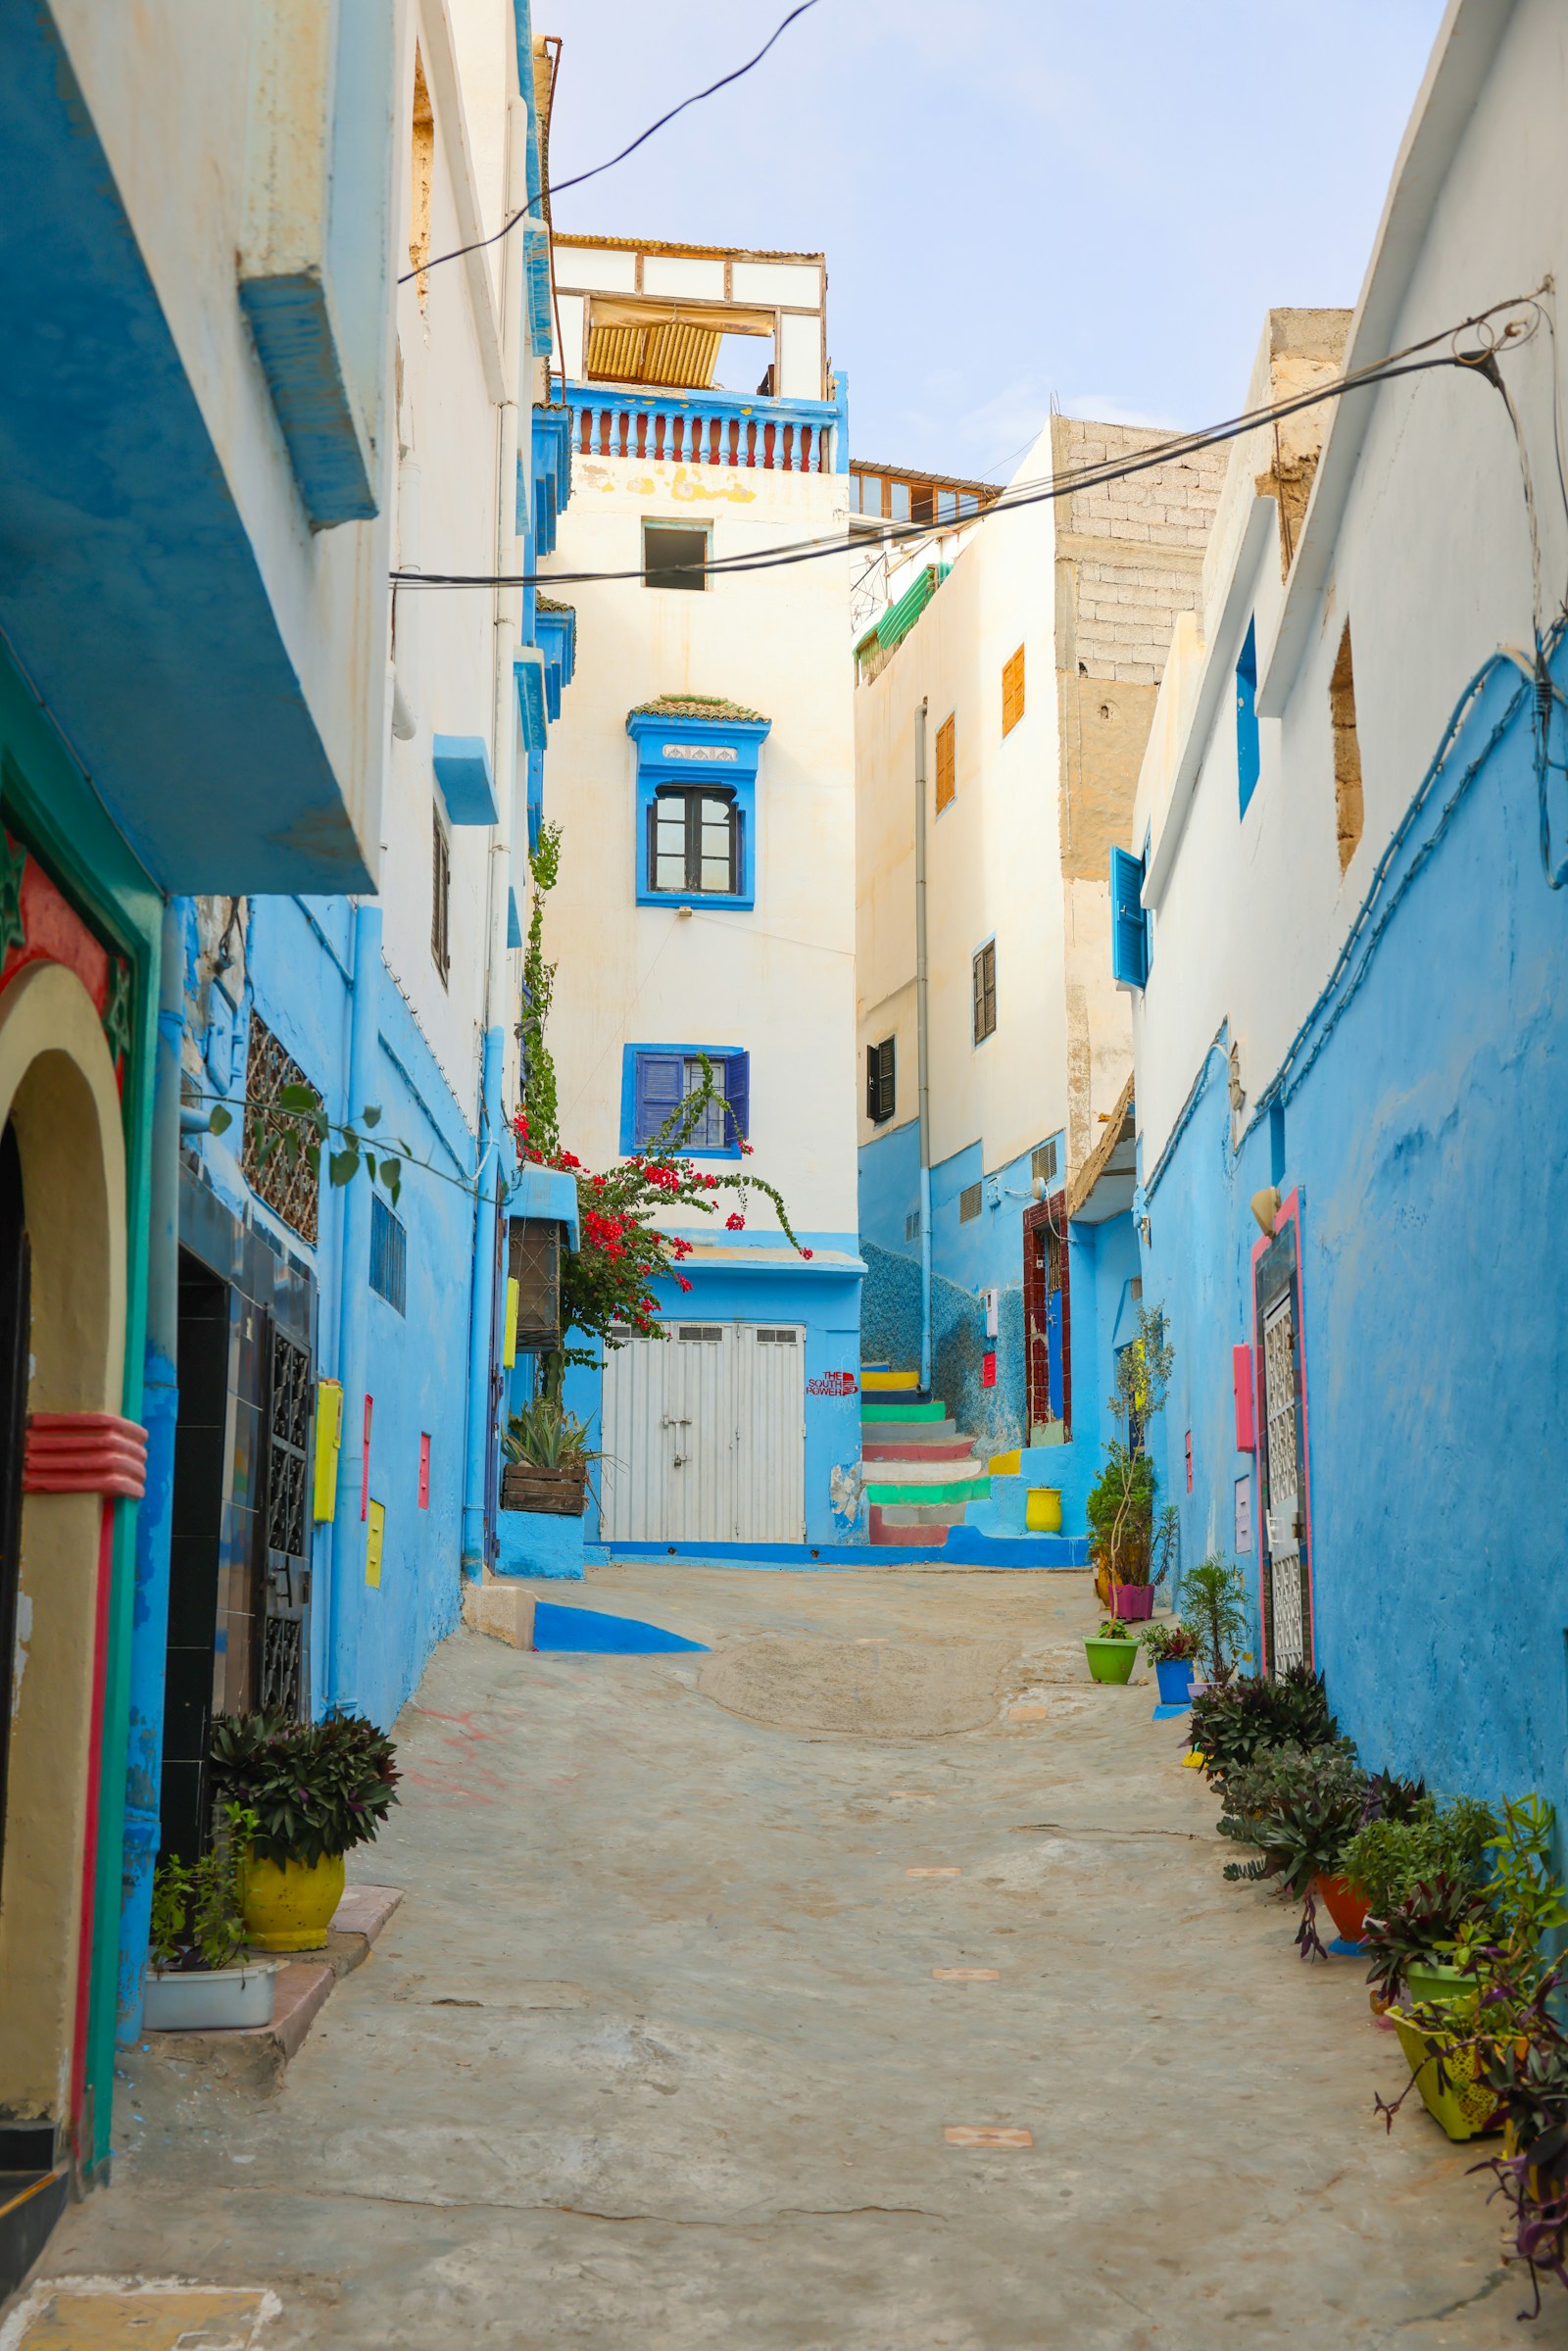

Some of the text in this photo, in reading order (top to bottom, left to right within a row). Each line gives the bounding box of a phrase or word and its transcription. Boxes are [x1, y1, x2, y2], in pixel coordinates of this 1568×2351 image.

[822, 1371, 842, 1380] THE
[808, 1379, 842, 1388] SOUTH
[806, 1387, 842, 1396] POWER
